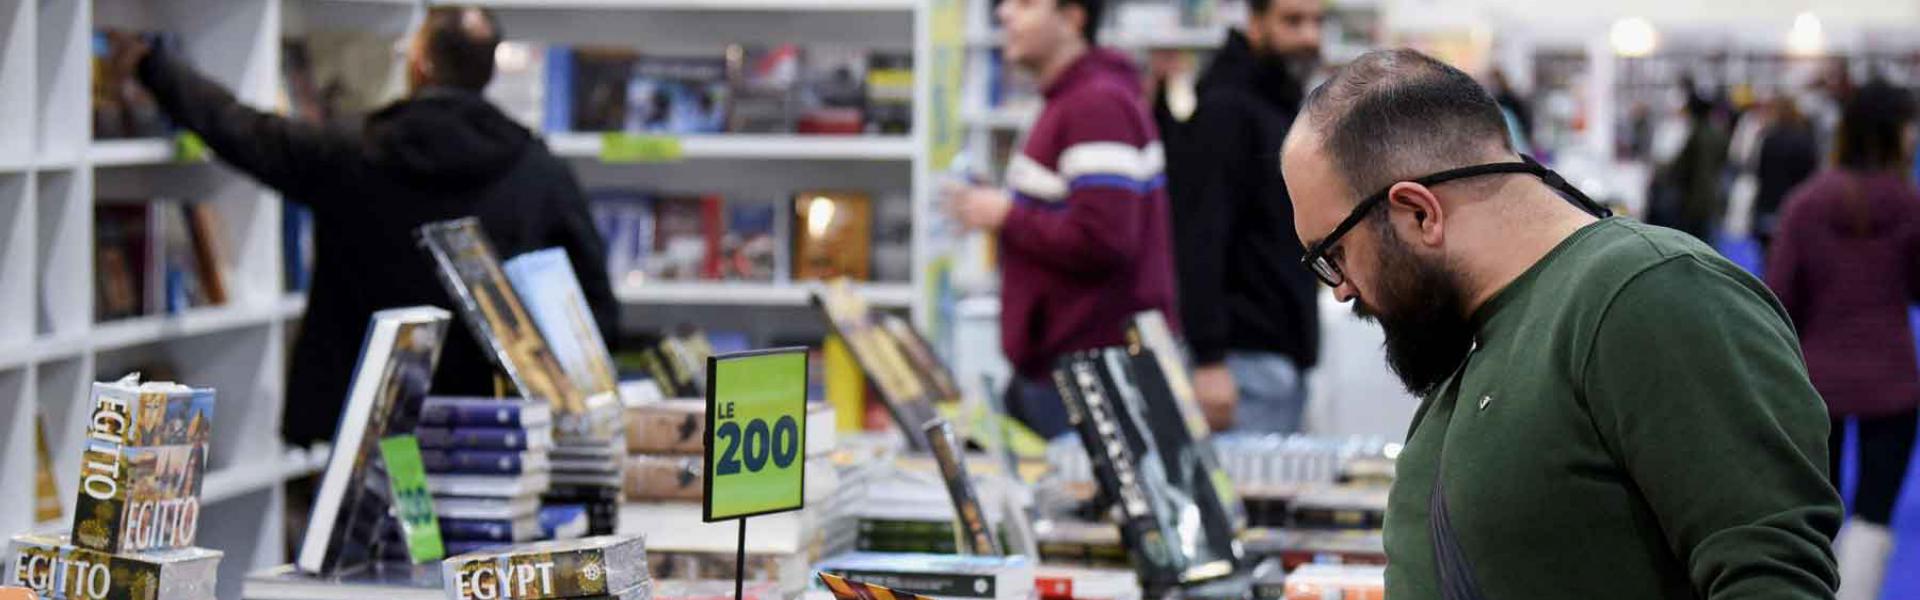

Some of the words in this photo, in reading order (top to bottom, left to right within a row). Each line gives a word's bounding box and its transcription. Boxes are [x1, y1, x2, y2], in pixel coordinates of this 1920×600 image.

[717, 402, 735, 420] LE
[84, 396, 128, 500] EGITTO
[716, 415, 798, 476] 200
[124, 497, 199, 549] EGITTO
[15, 552, 111, 599] EGITTO
[455, 562, 555, 600] EGYPT
